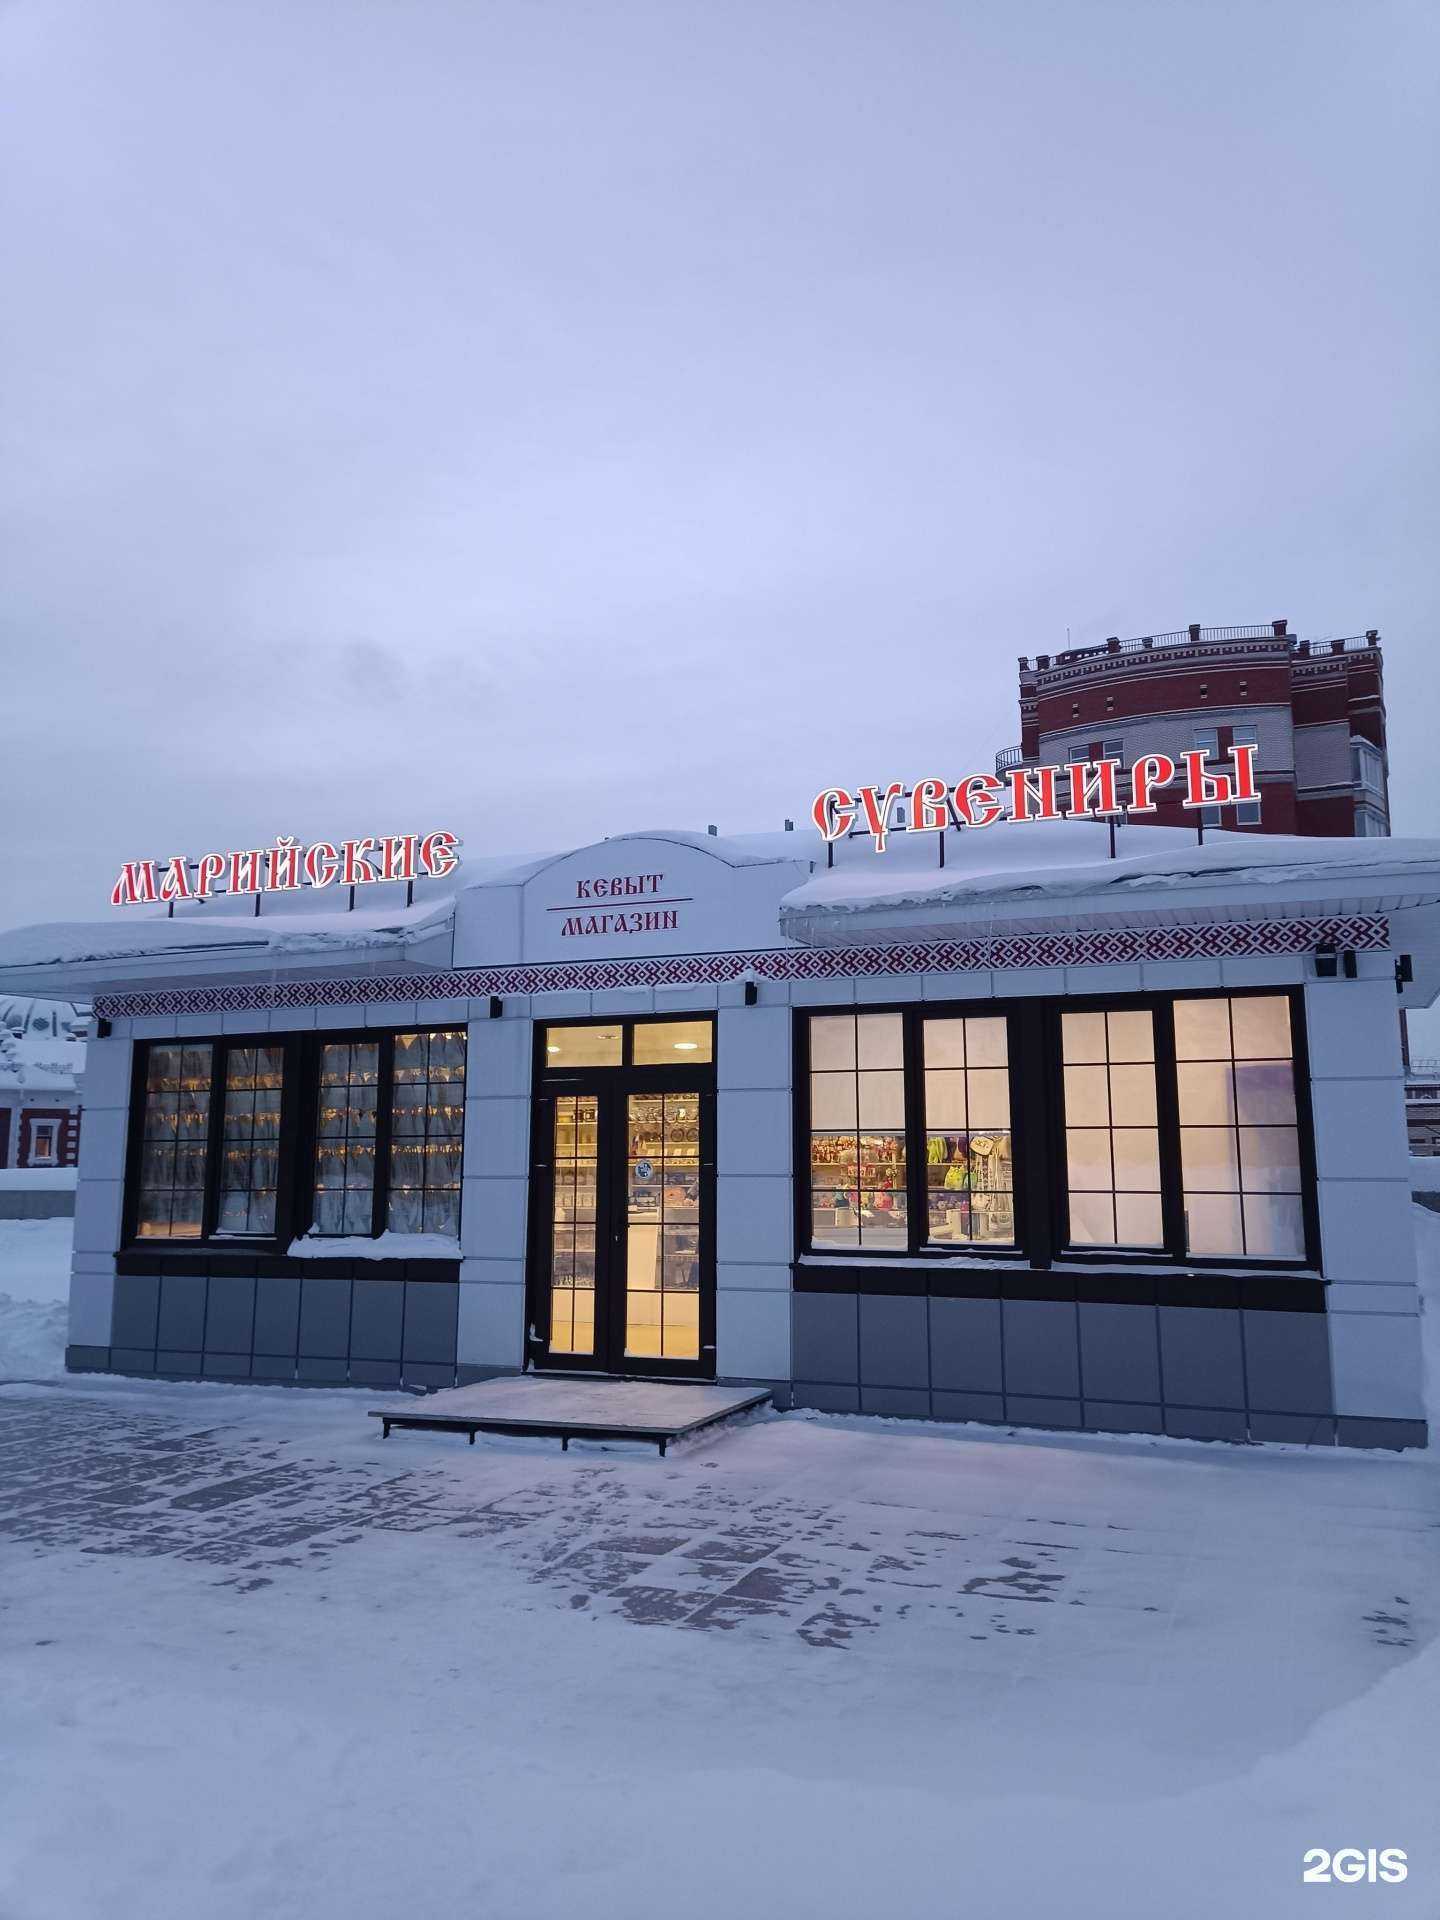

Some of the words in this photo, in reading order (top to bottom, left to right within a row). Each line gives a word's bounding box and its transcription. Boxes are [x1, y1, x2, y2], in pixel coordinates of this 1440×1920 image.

[811, 743, 1262, 853] СУВЕНИРЫ
[111, 830, 460, 906] МАРИЙСКИЕ
[576, 874, 664, 899] КЕВЫТ
[561, 910, 679, 937] МАГАЗИН
